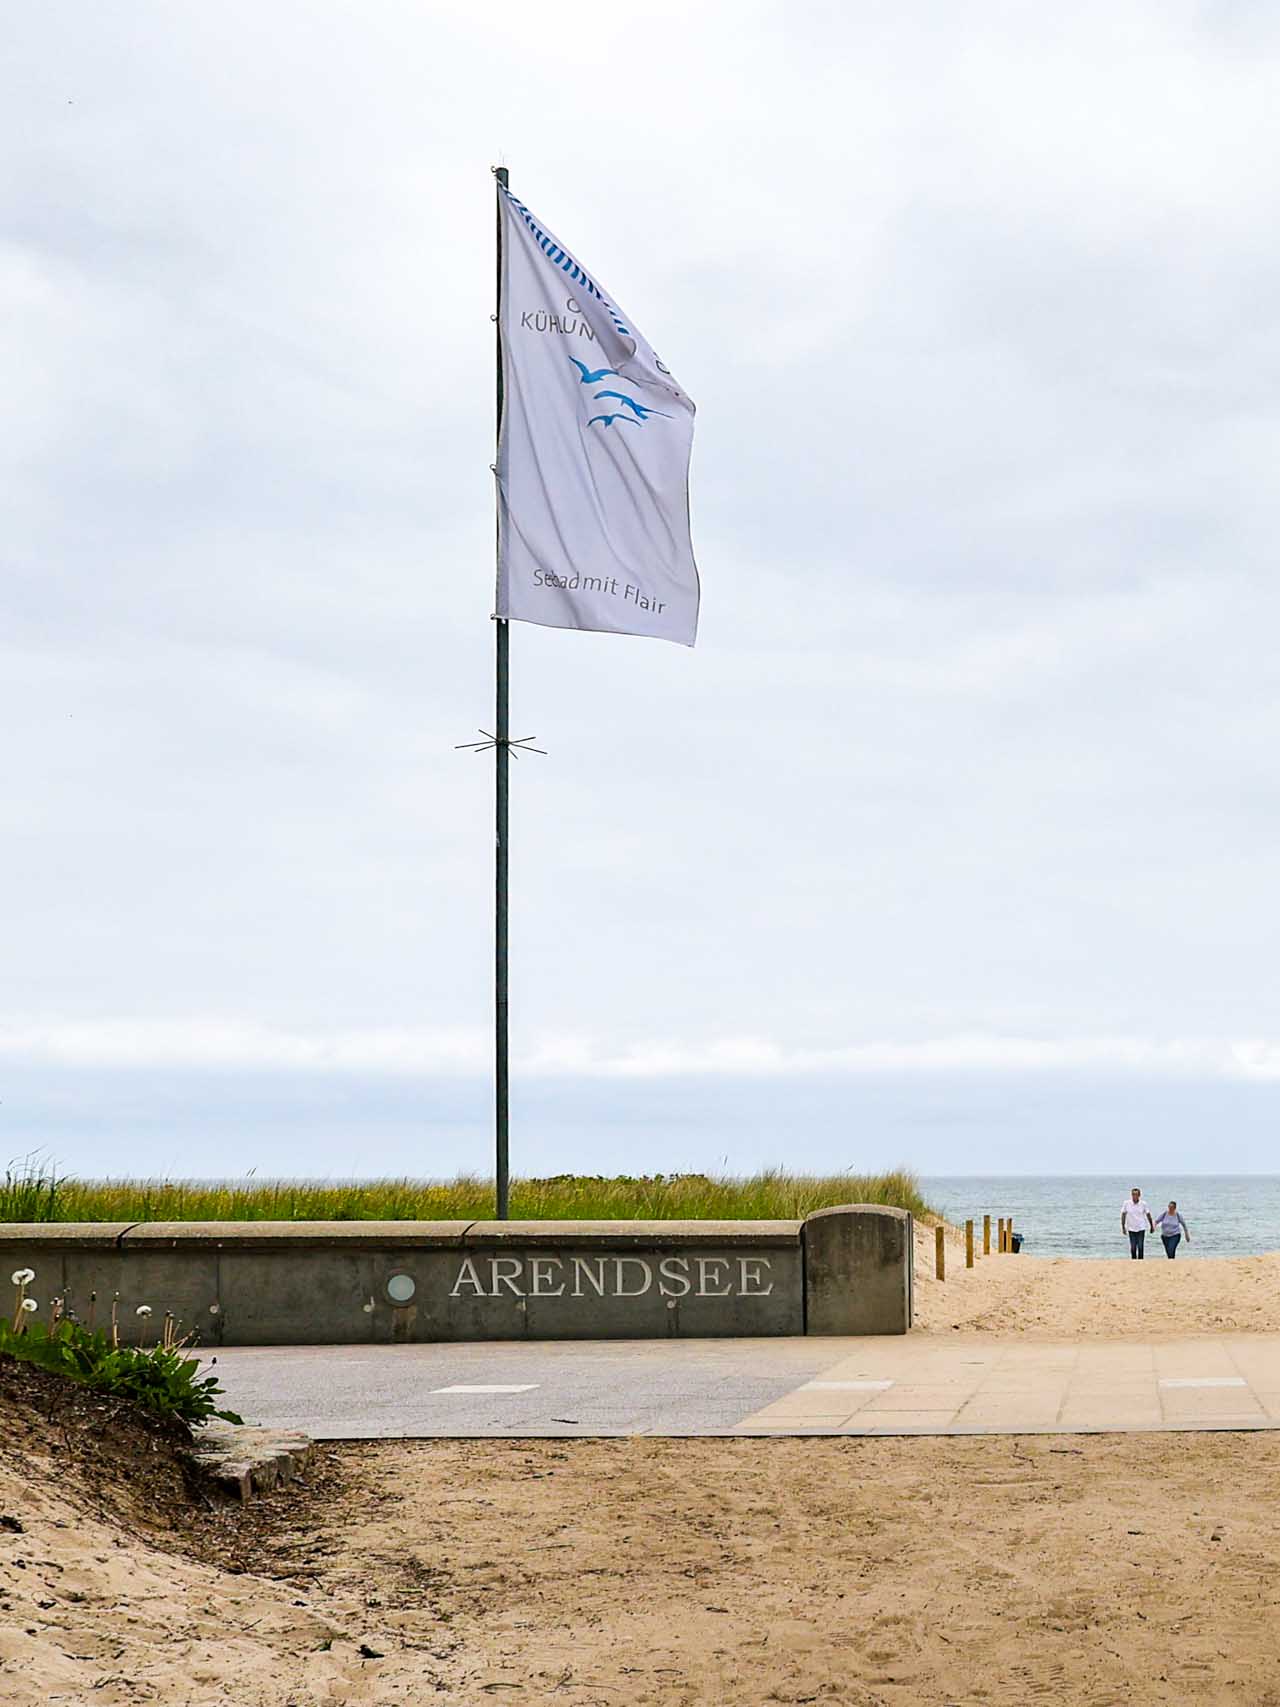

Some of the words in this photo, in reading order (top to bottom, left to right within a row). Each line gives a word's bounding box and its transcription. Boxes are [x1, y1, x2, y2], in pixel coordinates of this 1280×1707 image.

[583, 576, 619, 595] mit
[624, 584, 667, 614] Flair
[449, 1257, 774, 1297] ARENDSEE
